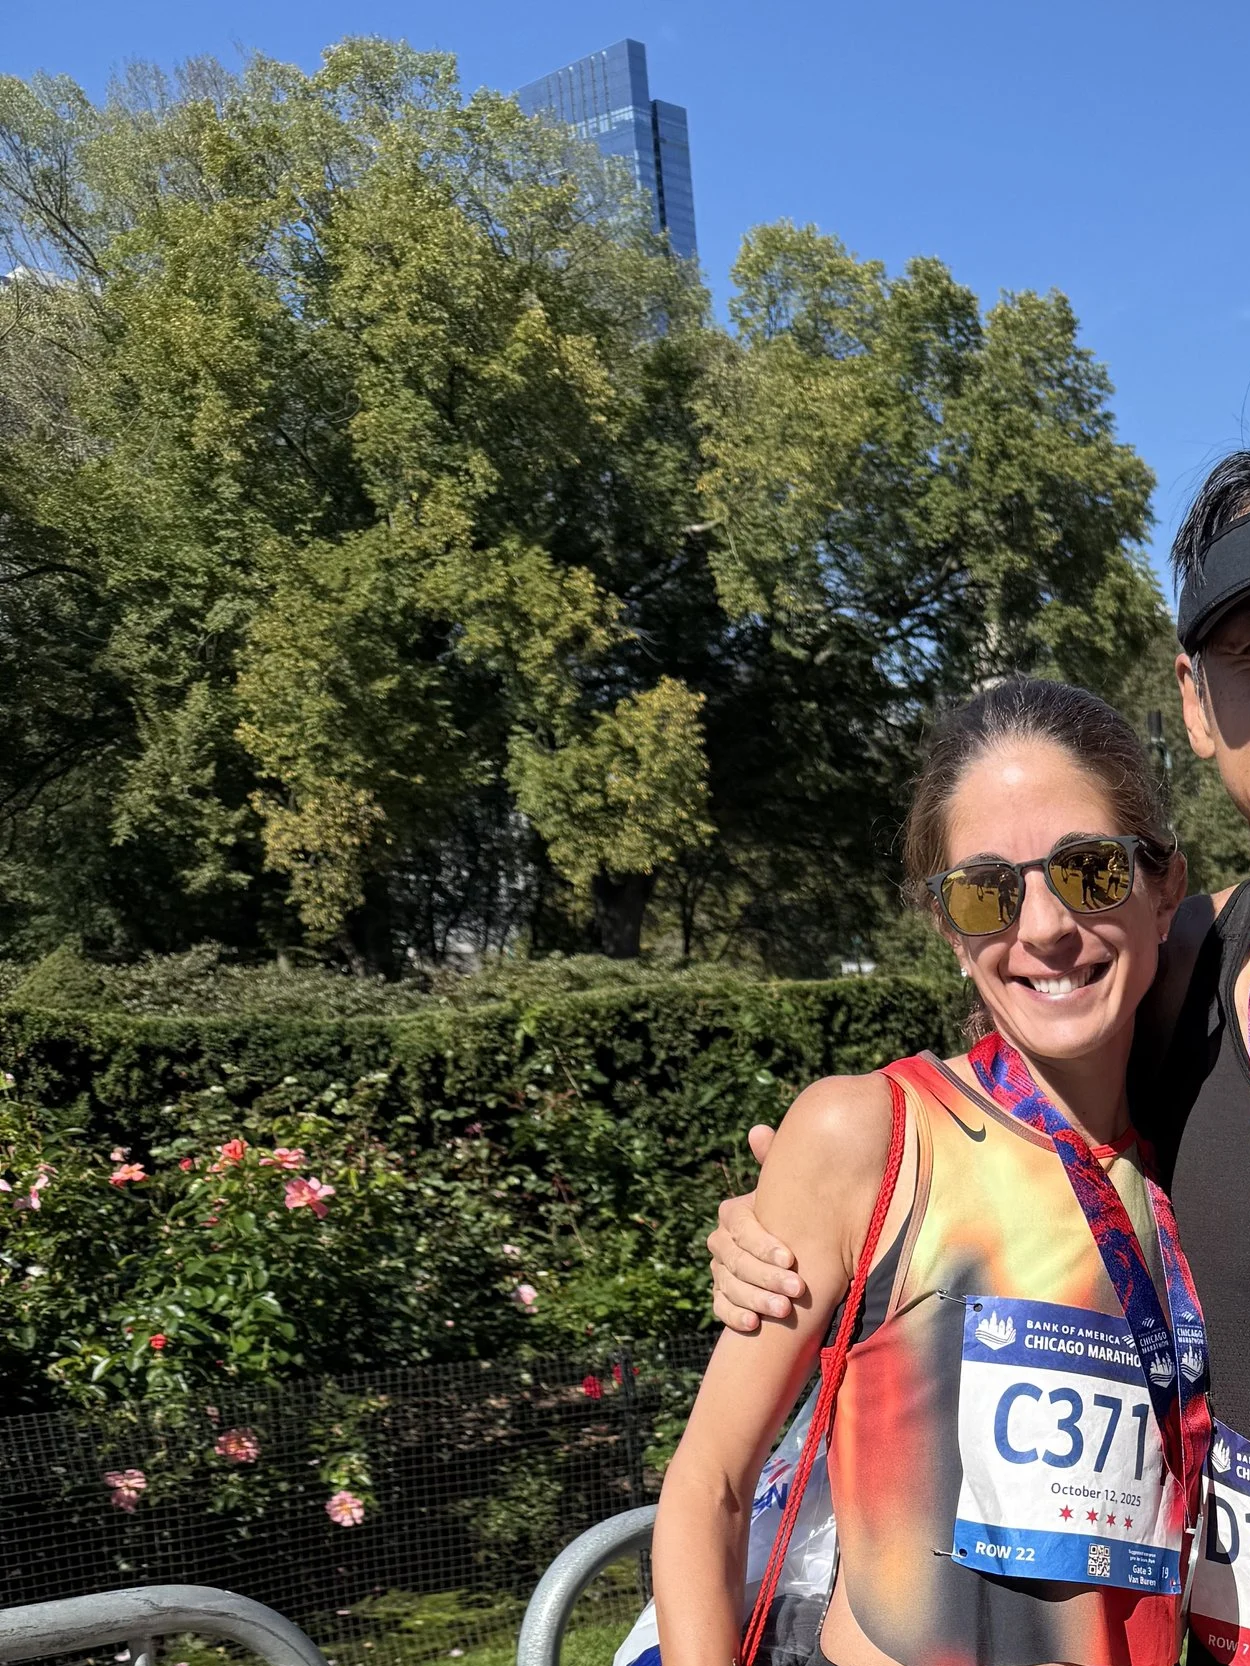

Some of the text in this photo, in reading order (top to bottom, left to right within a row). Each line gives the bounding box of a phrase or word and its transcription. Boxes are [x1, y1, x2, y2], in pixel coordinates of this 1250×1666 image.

[1026, 1319, 1059, 1334] BANK
[1061, 1325, 1076, 1336] OF
[1077, 1328, 1121, 1346] AMERICA
[1139, 1331, 1167, 1347] CHICAGO
[1024, 1334, 1141, 1368] CHICAGO MARATHO
[994, 1382, 1151, 1482] C371
[1051, 1482, 1142, 1507] October 12, 2025
[975, 1541, 1036, 1562] ROW 22
[1128, 1574, 1139, 1584] Van
[1132, 1564, 1153, 1576] Gate 3
[1208, 1633, 1250, 1656] ROW 7
